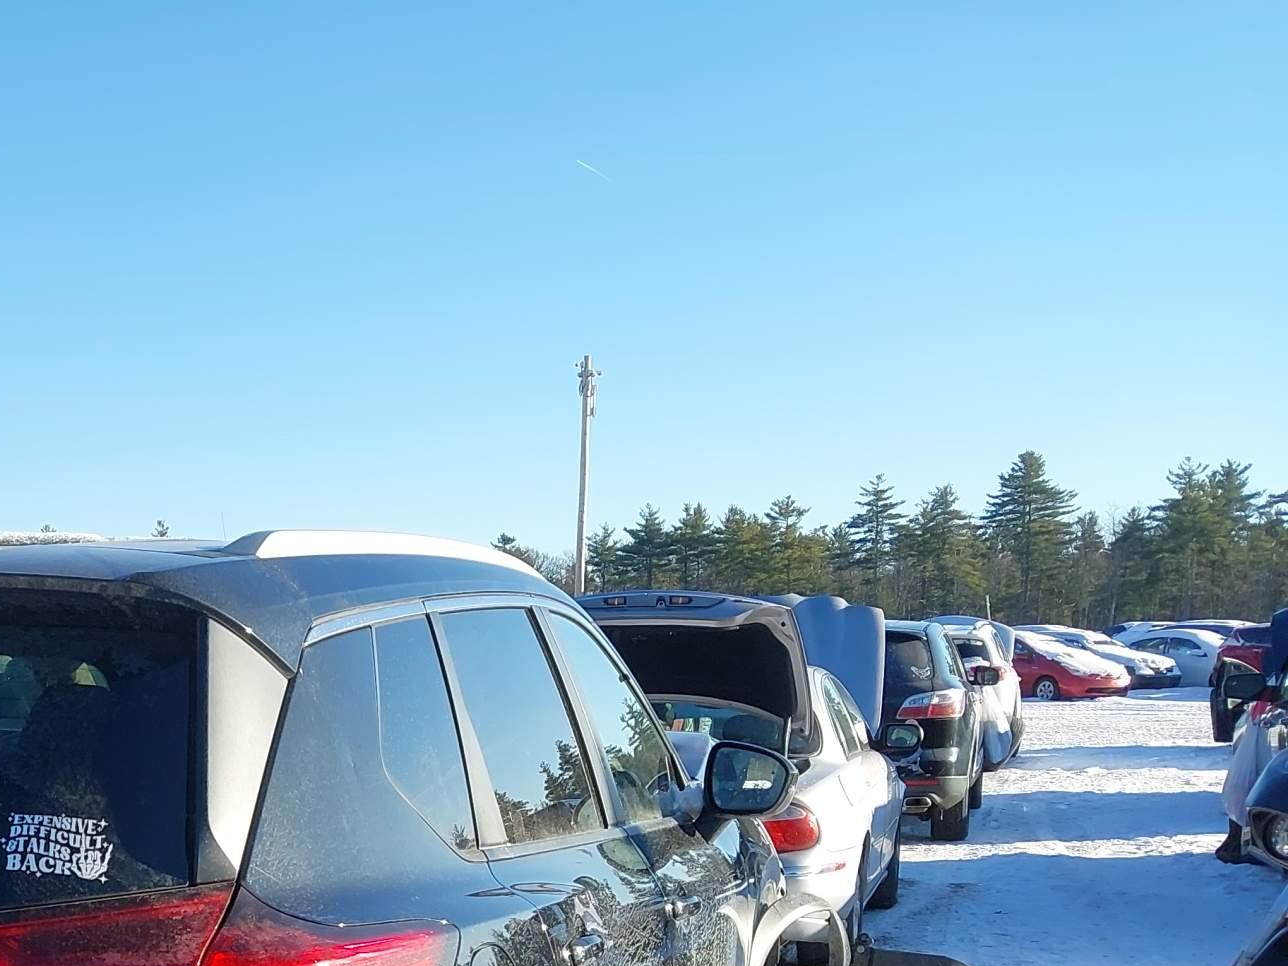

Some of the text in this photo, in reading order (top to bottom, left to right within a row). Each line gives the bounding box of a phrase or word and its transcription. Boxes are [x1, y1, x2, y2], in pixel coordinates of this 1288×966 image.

[13, 813, 98, 835] EXPENSIVE
[9, 824, 107, 850] DIFFICULT
[5, 853, 72, 876] BACK
